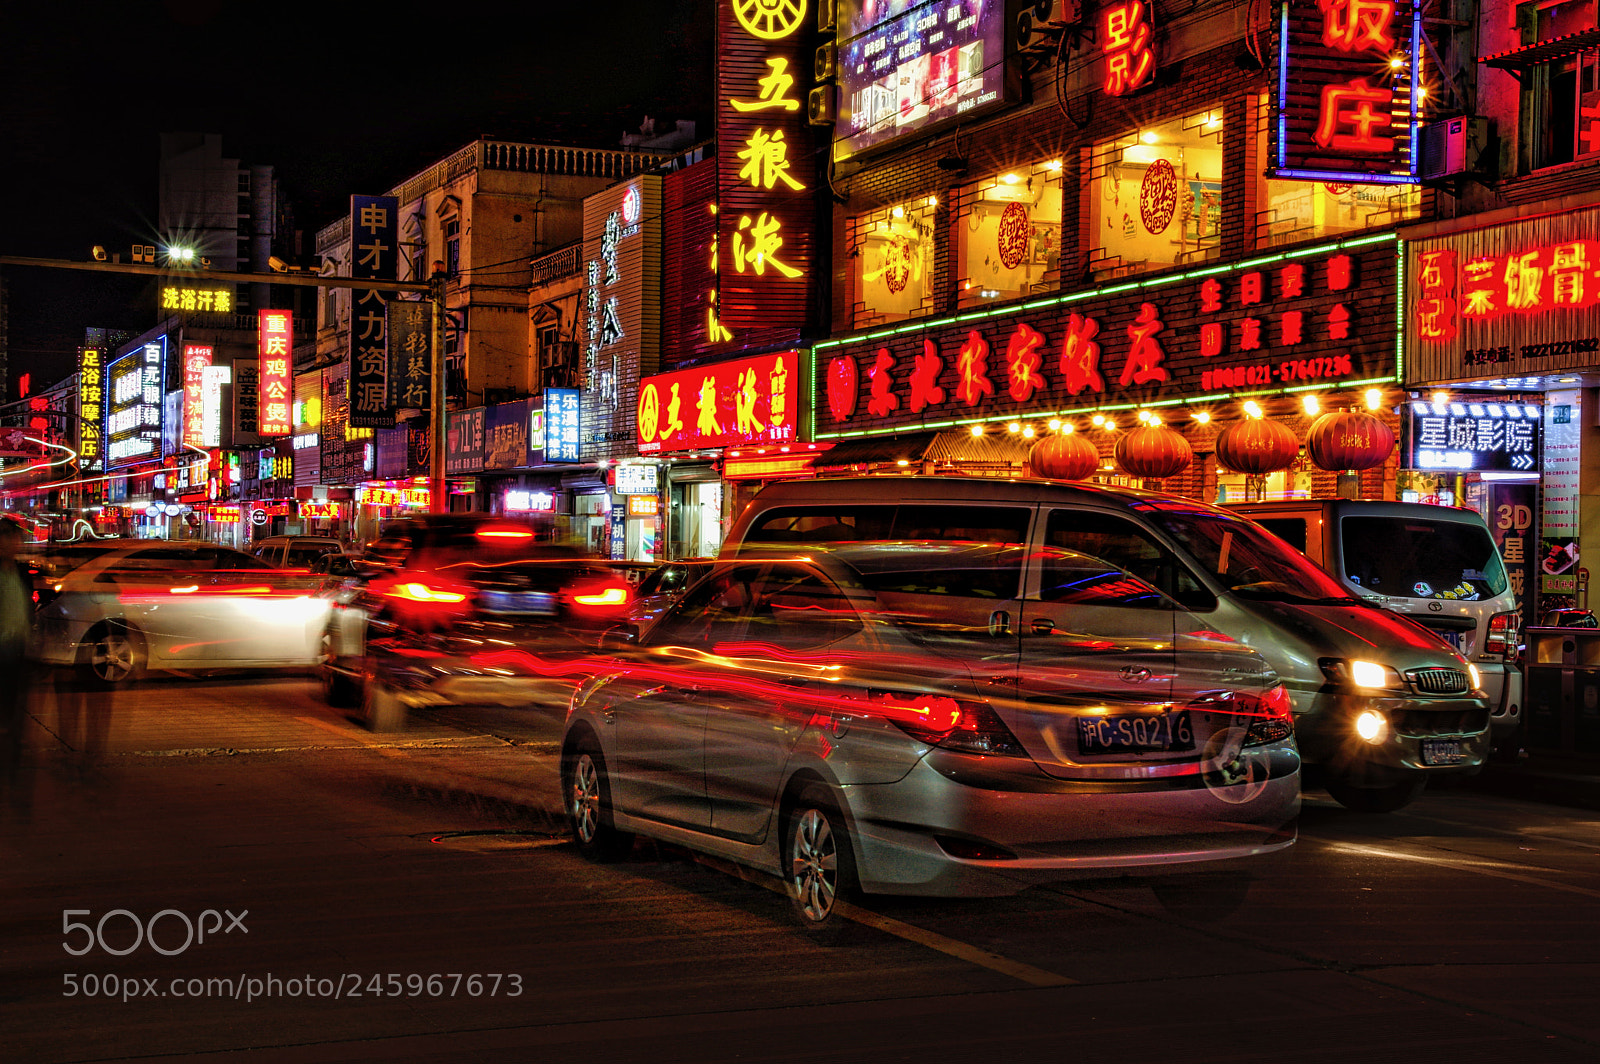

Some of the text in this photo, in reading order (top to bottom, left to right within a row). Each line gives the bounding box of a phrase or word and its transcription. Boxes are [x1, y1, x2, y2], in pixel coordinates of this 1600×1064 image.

[1104, 1, 1152, 95] 影
[1313, 0, 1394, 151] 饭庄
[730, 57, 806, 278] 五粮液
[163, 287, 231, 312] 洗浴汗蒸
[357, 203, 389, 413] 申才人力资源
[1418, 251, 1447, 337] 石记
[1463, 243, 1600, 316] 菜饭骨
[144, 344, 161, 425] 百元眼镜
[266, 314, 287, 421] 重庆鸡公煲
[1419, 417, 1533, 452] 星城影院
[611, 506, 625, 560] 手机维
